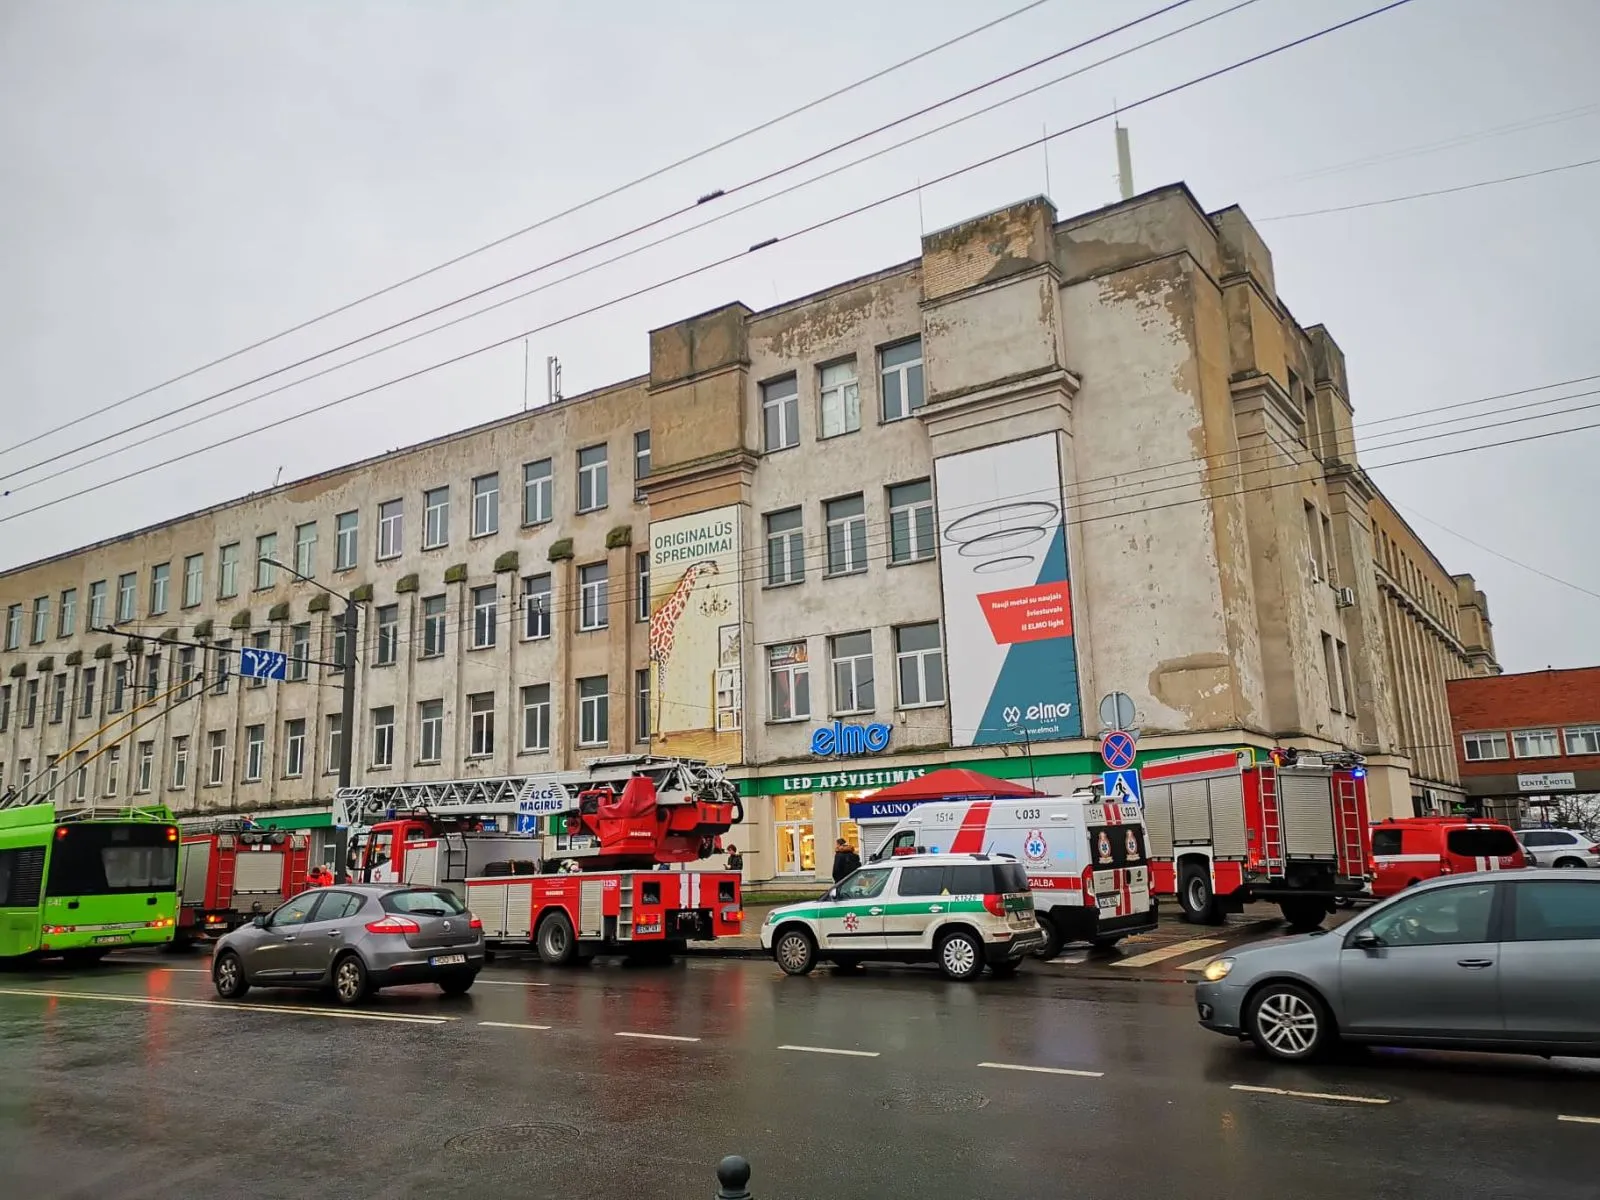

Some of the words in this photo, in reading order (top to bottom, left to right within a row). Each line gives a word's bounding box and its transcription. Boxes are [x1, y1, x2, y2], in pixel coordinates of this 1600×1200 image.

[655, 521, 733, 549] ORIGINALŪS
[655, 538, 732, 564] SPRENDIMAI
[1028, 621, 1047, 630] ELMO
[1025, 702, 1071, 720] elmo
[1020, 724, 1059, 735] www.elmo.lt
[809, 720, 893, 756] elmo
[783, 777, 812, 790] LED
[820, 768, 926, 788] APŠVIETIMAS
[530, 790, 540, 800] 42
[541, 789, 553, 799] CS
[519, 800, 563, 812] MAGIRUS
[872, 803, 911, 815] KAUNO
[1125, 806, 1137, 818] 033
[936, 812, 954, 823] 1514
[1022, 809, 1041, 820] 033
[1089, 809, 1104, 820] 1514
